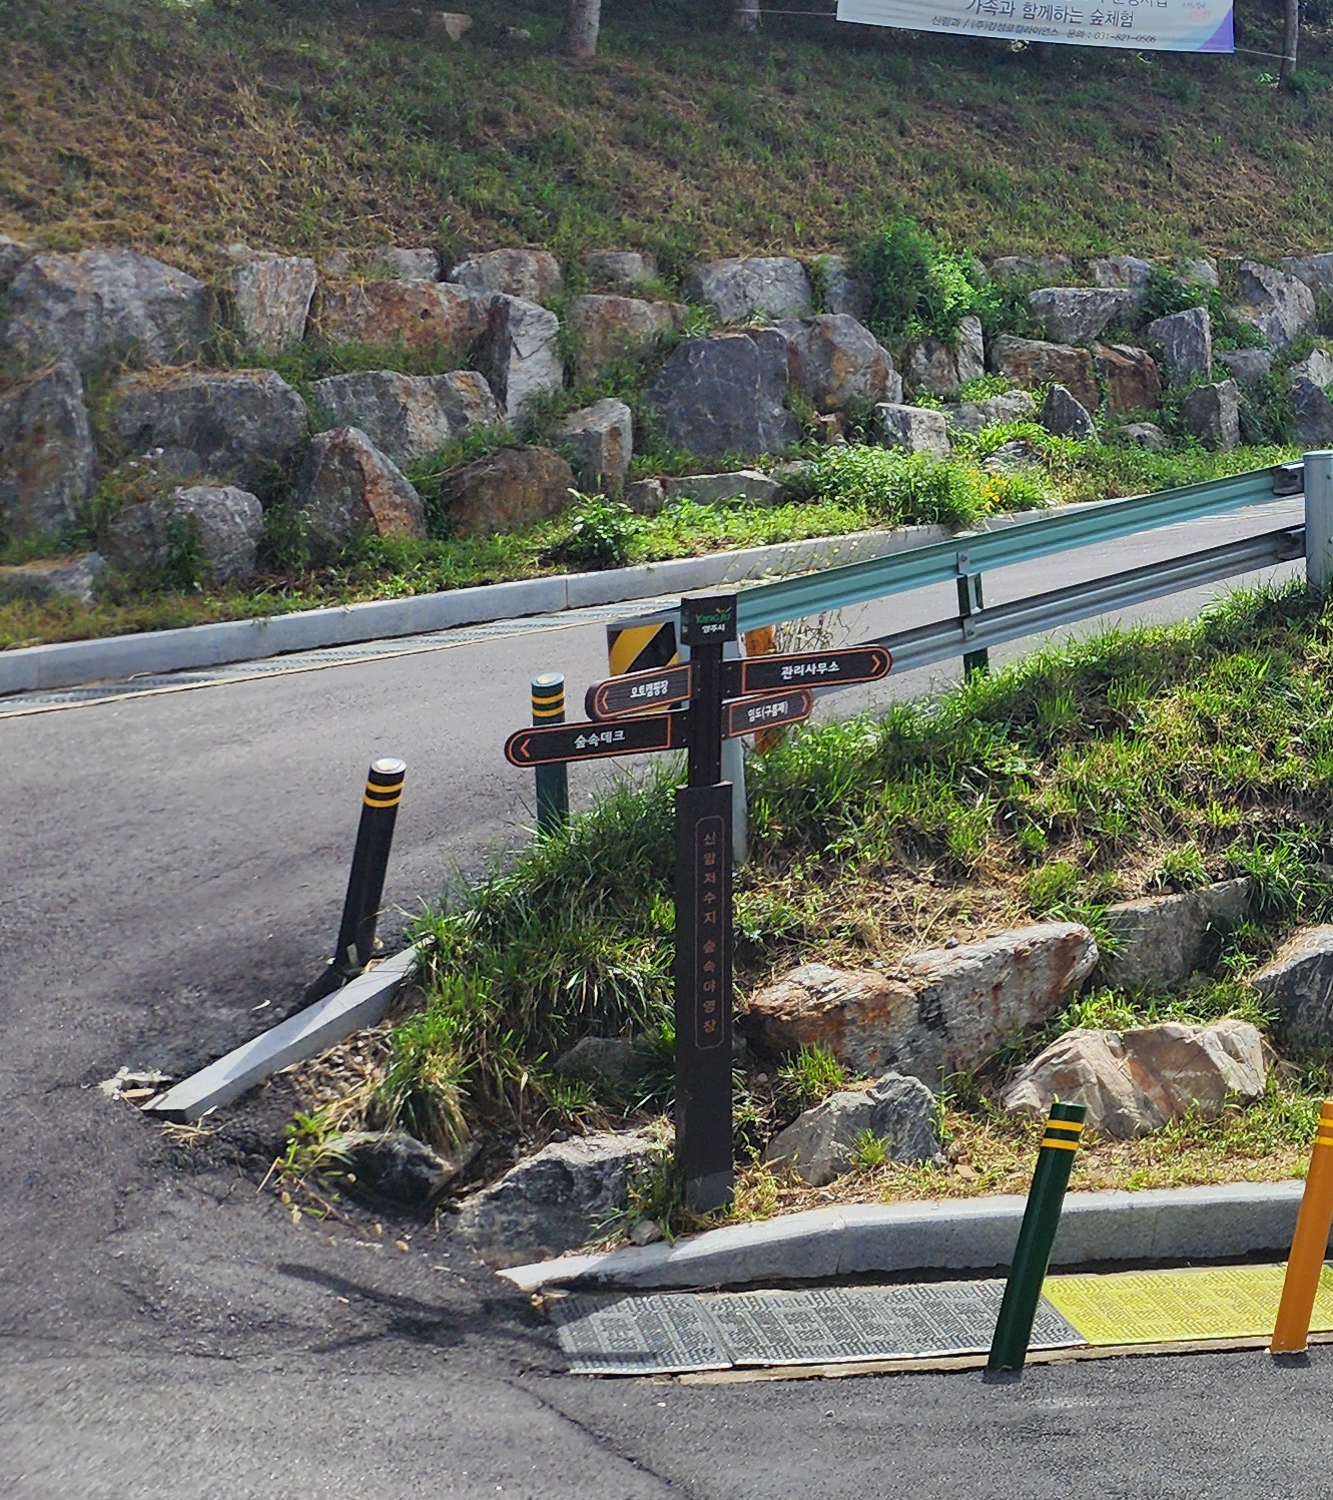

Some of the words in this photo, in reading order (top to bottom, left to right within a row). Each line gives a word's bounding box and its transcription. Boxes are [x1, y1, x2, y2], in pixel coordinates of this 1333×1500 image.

[1023, 2, 1084, 24] 함께하는
[1090, 8, 1134, 28] 숲체험
[780, 660, 841, 680] 관리사무소
[629, 679, 669, 698] 오토캠핑장
[573, 729, 626, 750] 숲속데크
